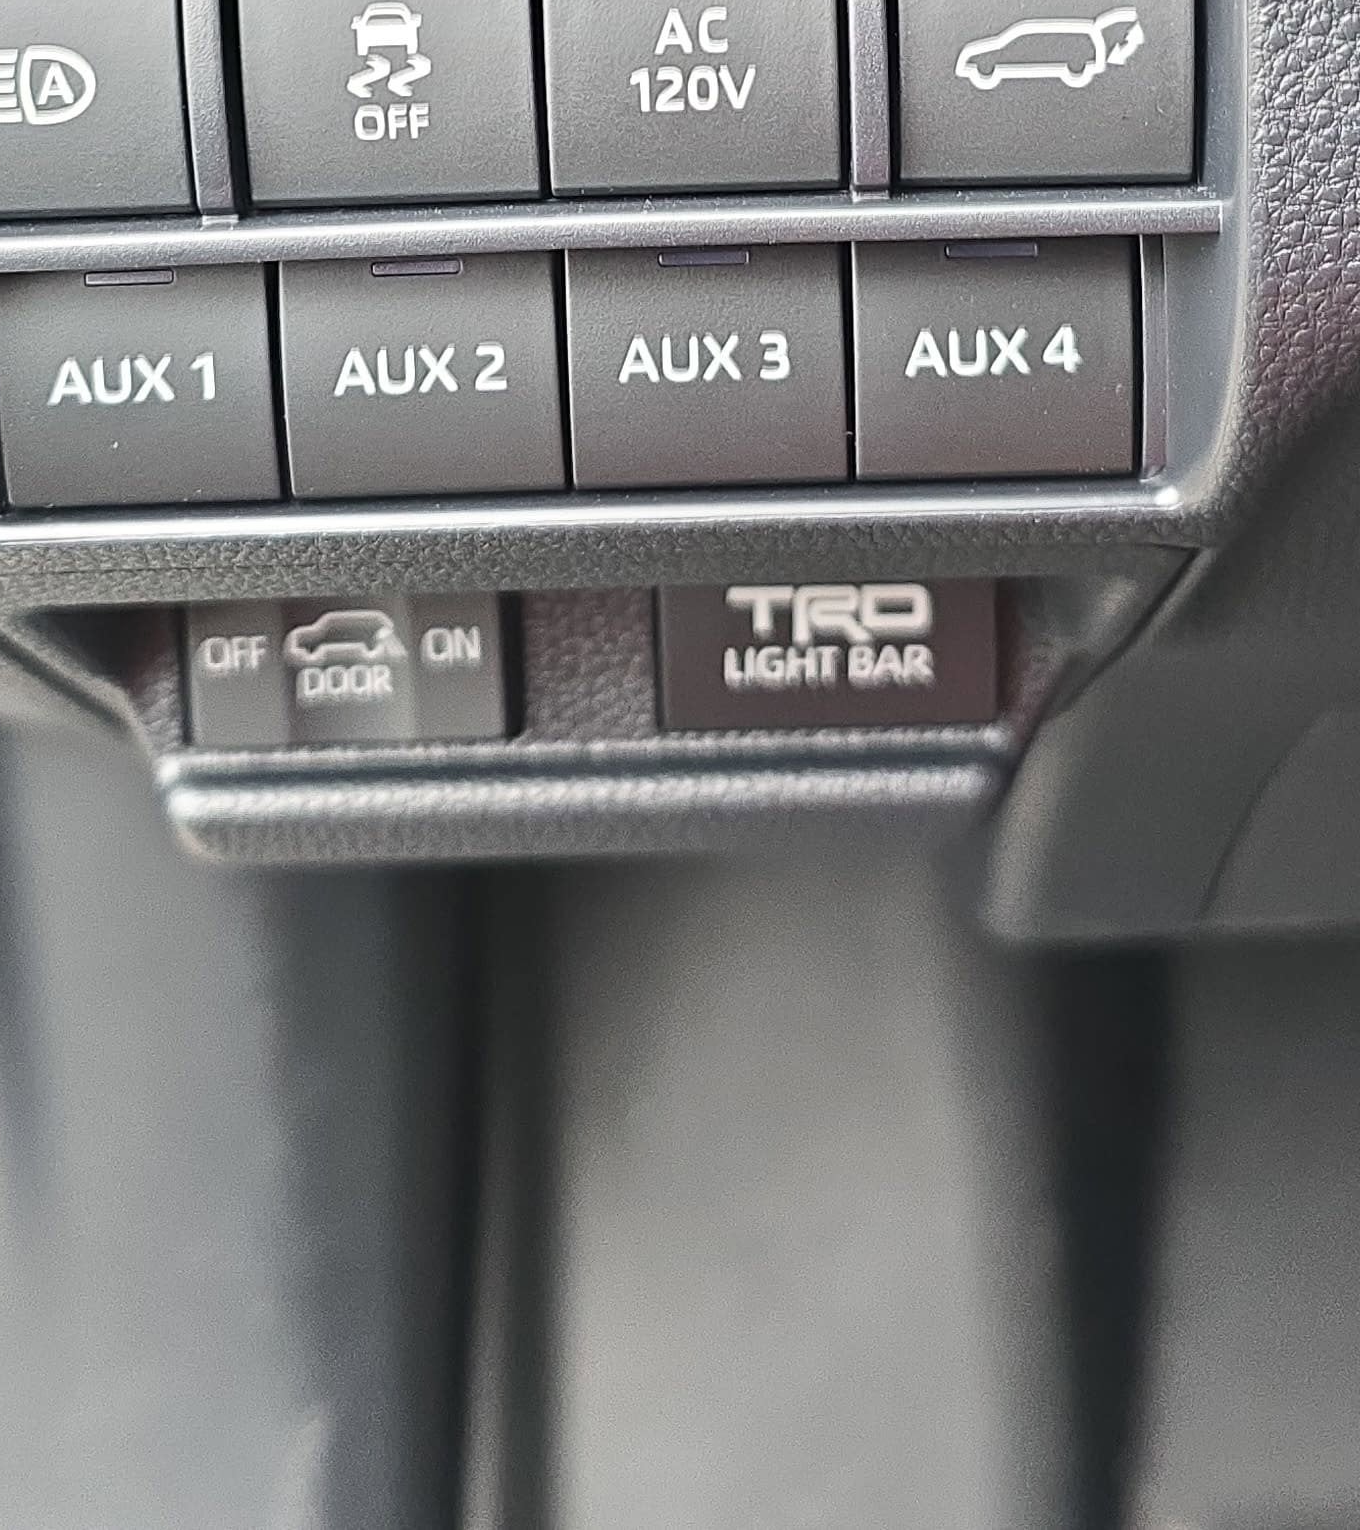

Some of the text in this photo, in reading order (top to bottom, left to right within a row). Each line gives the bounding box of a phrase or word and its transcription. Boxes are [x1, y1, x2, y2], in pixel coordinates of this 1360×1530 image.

[654, 7, 730, 55] AC
[36, 61, 75, 106] A
[629, 65, 757, 113] 120V
[354, 104, 430, 141] OFF
[334, 343, 508, 396] AUX 2
[618, 330, 791, 384] AUX 3
[904, 325, 1082, 378] AUX 4
[48, 352, 217, 404] AUX 1
[726, 584, 932, 644] TRD
[202, 635, 267, 672] OFF
[421, 627, 481, 662] ON
[724, 643, 934, 687] LIGHT BAR
[300, 665, 393, 701] DOOR
